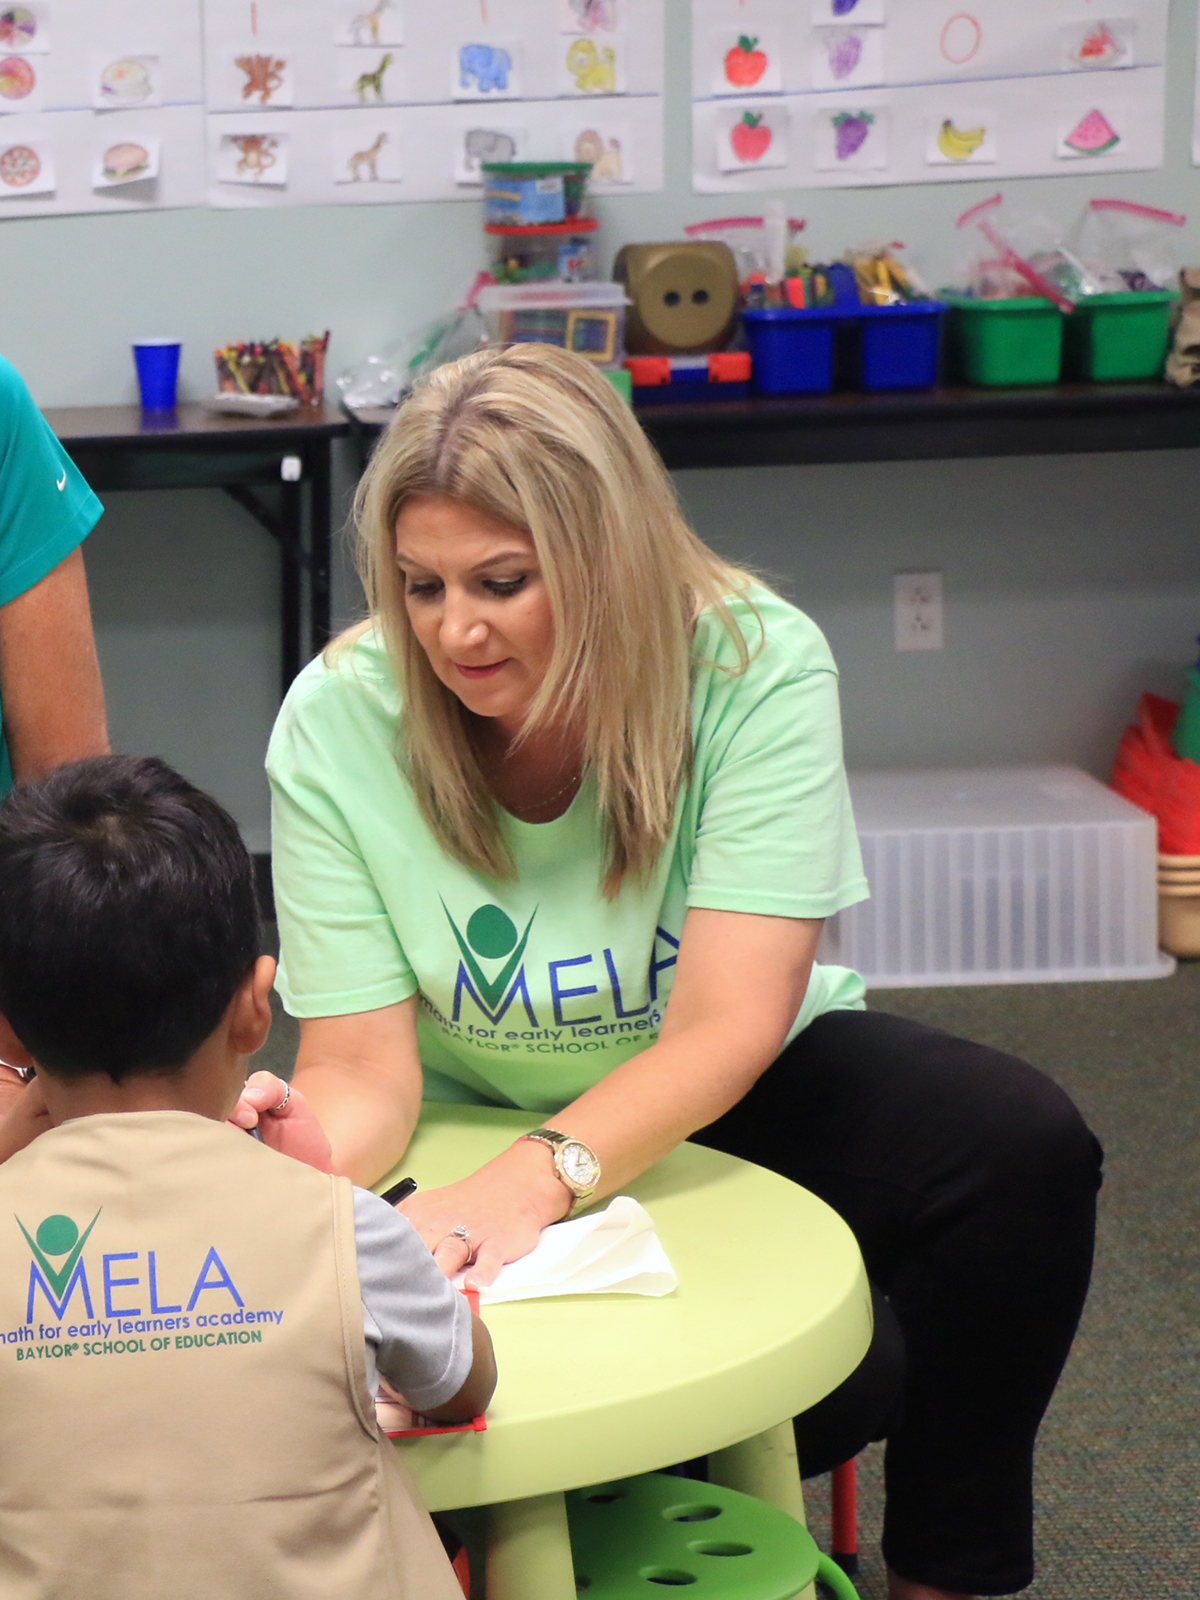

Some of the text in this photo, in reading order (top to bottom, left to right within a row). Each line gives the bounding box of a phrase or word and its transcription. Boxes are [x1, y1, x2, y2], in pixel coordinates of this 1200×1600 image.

[451, 924, 680, 1028] MELA
[420, 995, 461, 1032] math
[468, 1024, 497, 1039] for
[505, 1027, 563, 1041] early
[526, 1038, 608, 1054] SCHOOL
[615, 1033, 642, 1046] OF
[26, 1246, 245, 1324] MELA
[38, 1323, 62, 1341] for
[67, 1319, 112, 1339] early
[117, 1315, 190, 1335] learners
[196, 1308, 284, 1328] academy
[83, 1338, 146, 1356] SCHOOL
[150, 1336, 171, 1351] OF
[175, 1330, 263, 1349] EDUCATION
